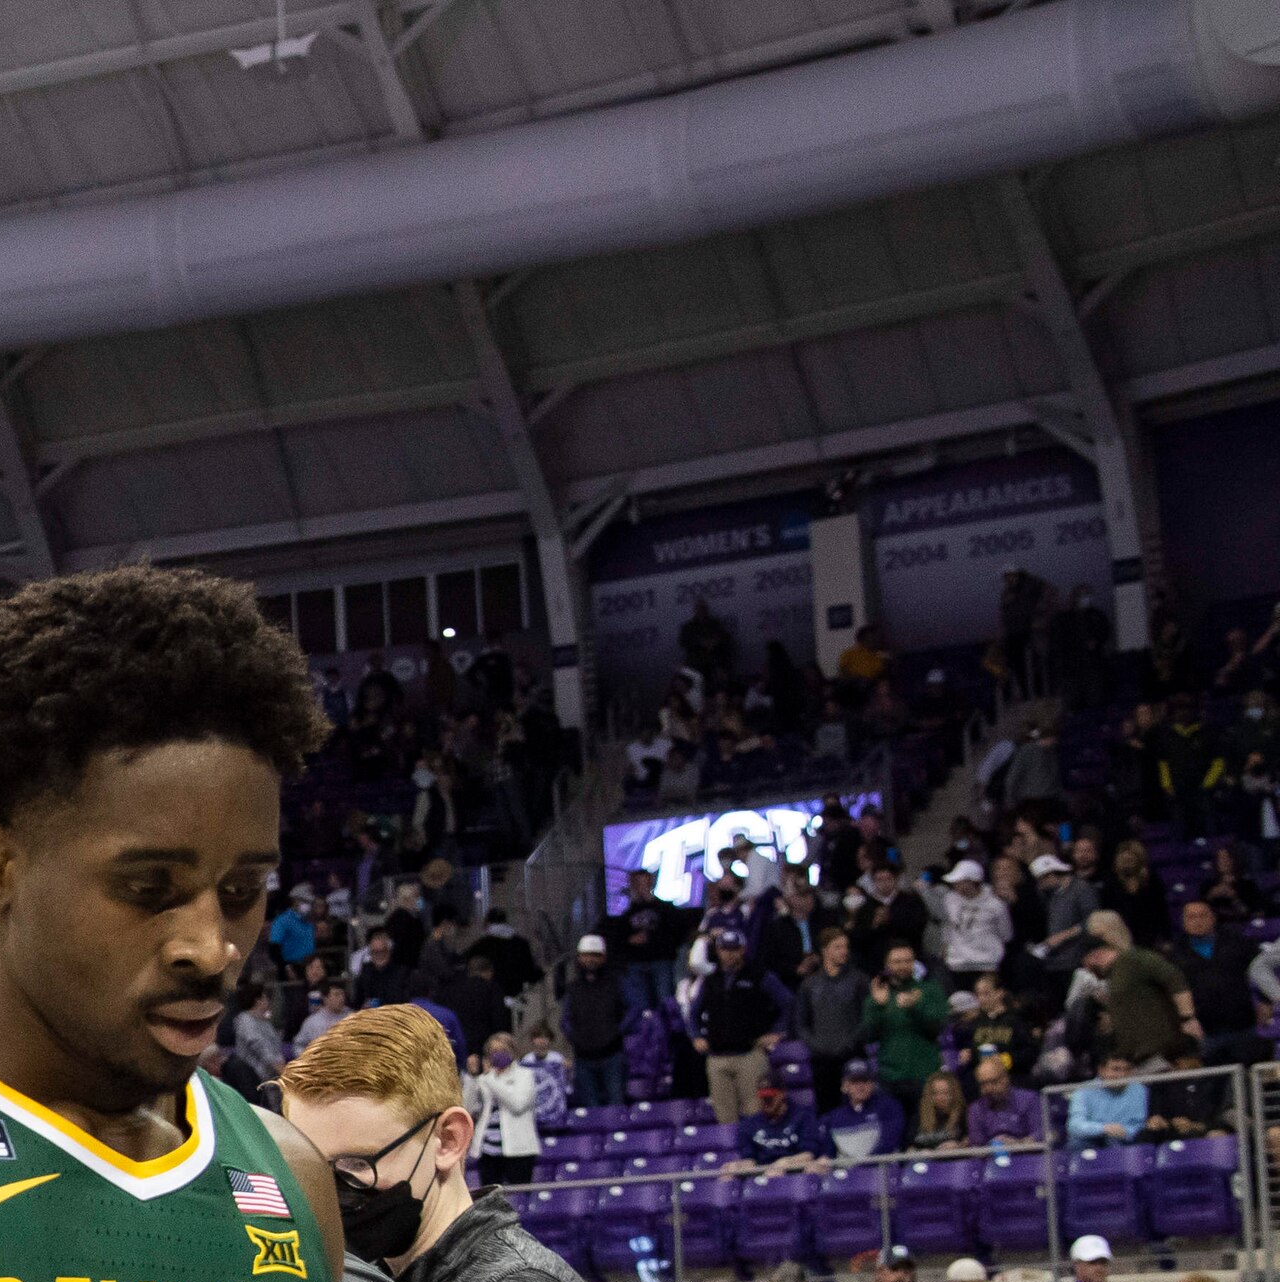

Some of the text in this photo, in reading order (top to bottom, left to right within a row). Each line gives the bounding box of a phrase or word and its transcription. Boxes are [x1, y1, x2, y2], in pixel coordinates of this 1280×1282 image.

[883, 474, 1073, 524] APPEARANCES
[652, 523, 771, 563] WOMEN'S
[884, 542, 948, 571] 2004
[599, 588, 656, 617] 2001
[675, 576, 736, 606] 2002
